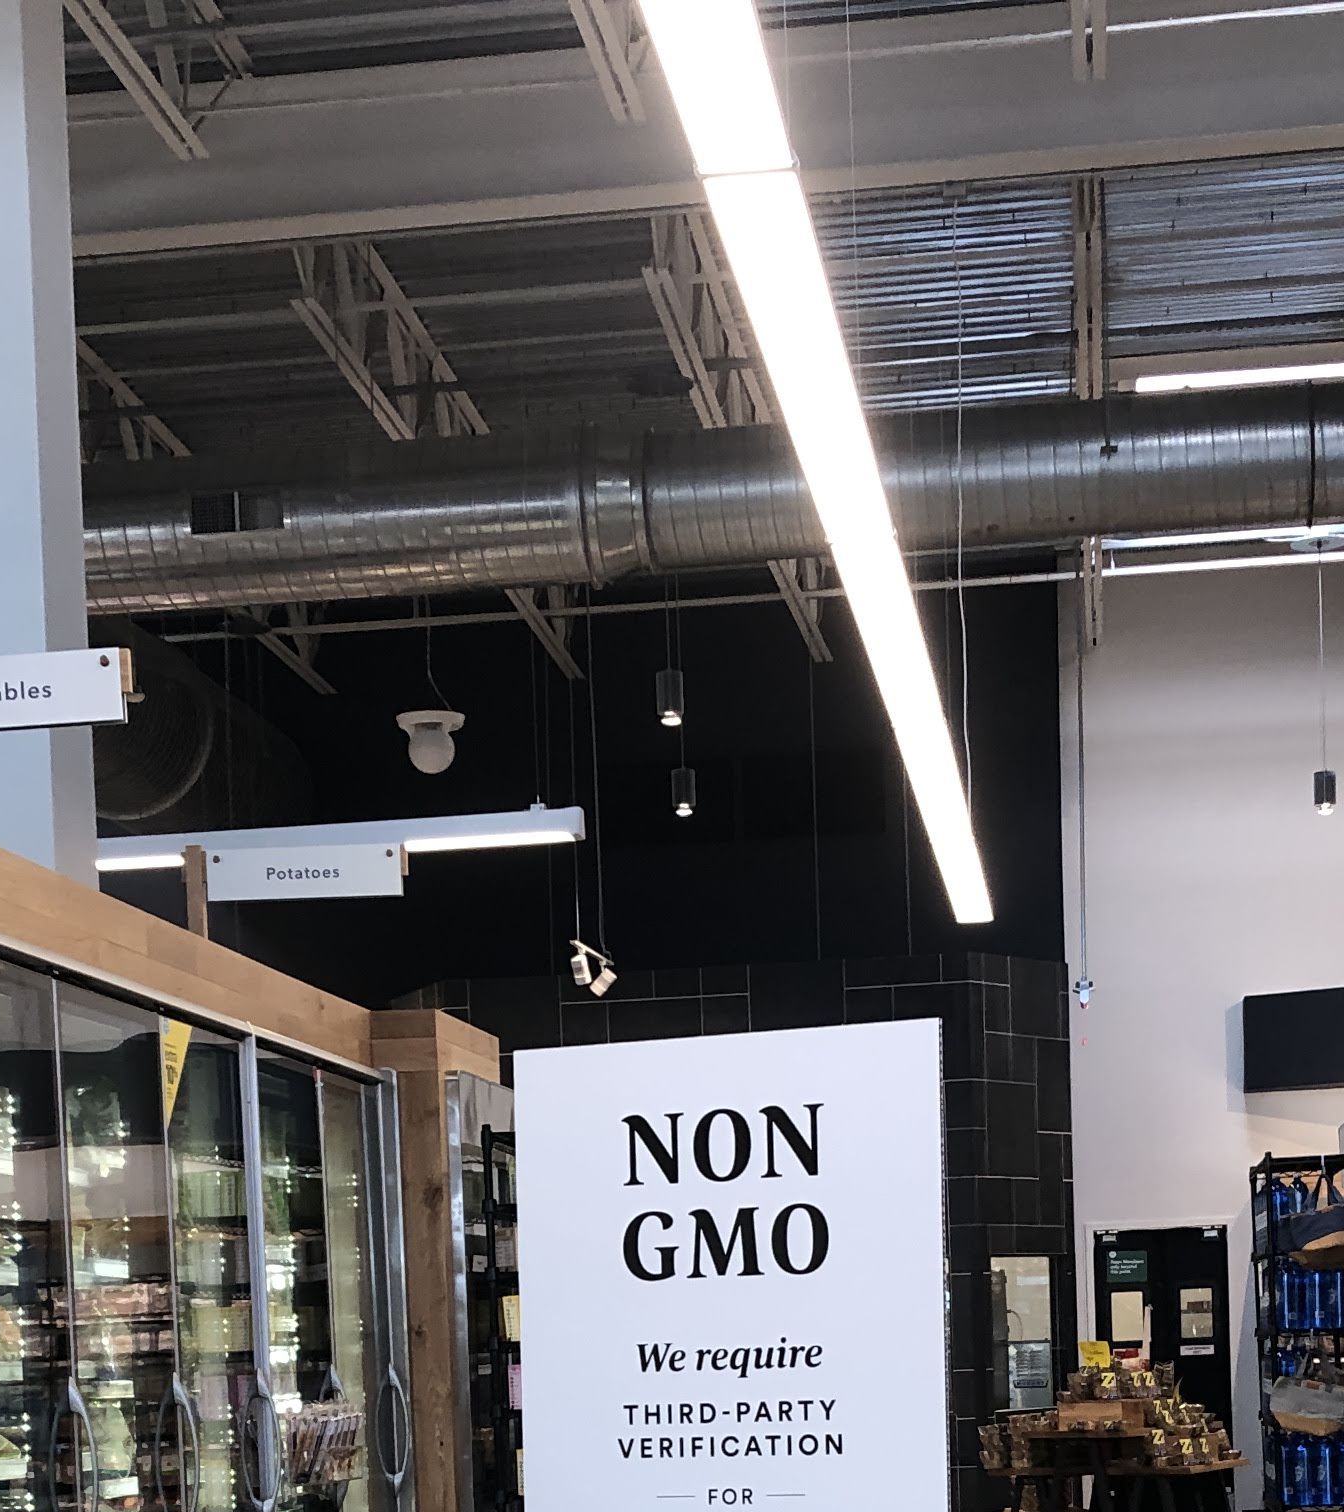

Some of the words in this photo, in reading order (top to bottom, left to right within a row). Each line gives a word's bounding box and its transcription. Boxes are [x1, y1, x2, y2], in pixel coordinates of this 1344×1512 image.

[266, 866, 340, 880] Potatoes
[620, 1103, 825, 1187] NON
[622, 1202, 830, 1282] GMO
[637, 1342, 686, 1373] We
[695, 1336, 823, 1379] require
[622, 1399, 836, 1426] THIRD-PARTY
[617, 1433, 843, 1459] VERIFICATION
[708, 1488, 753, 1506] FOR
